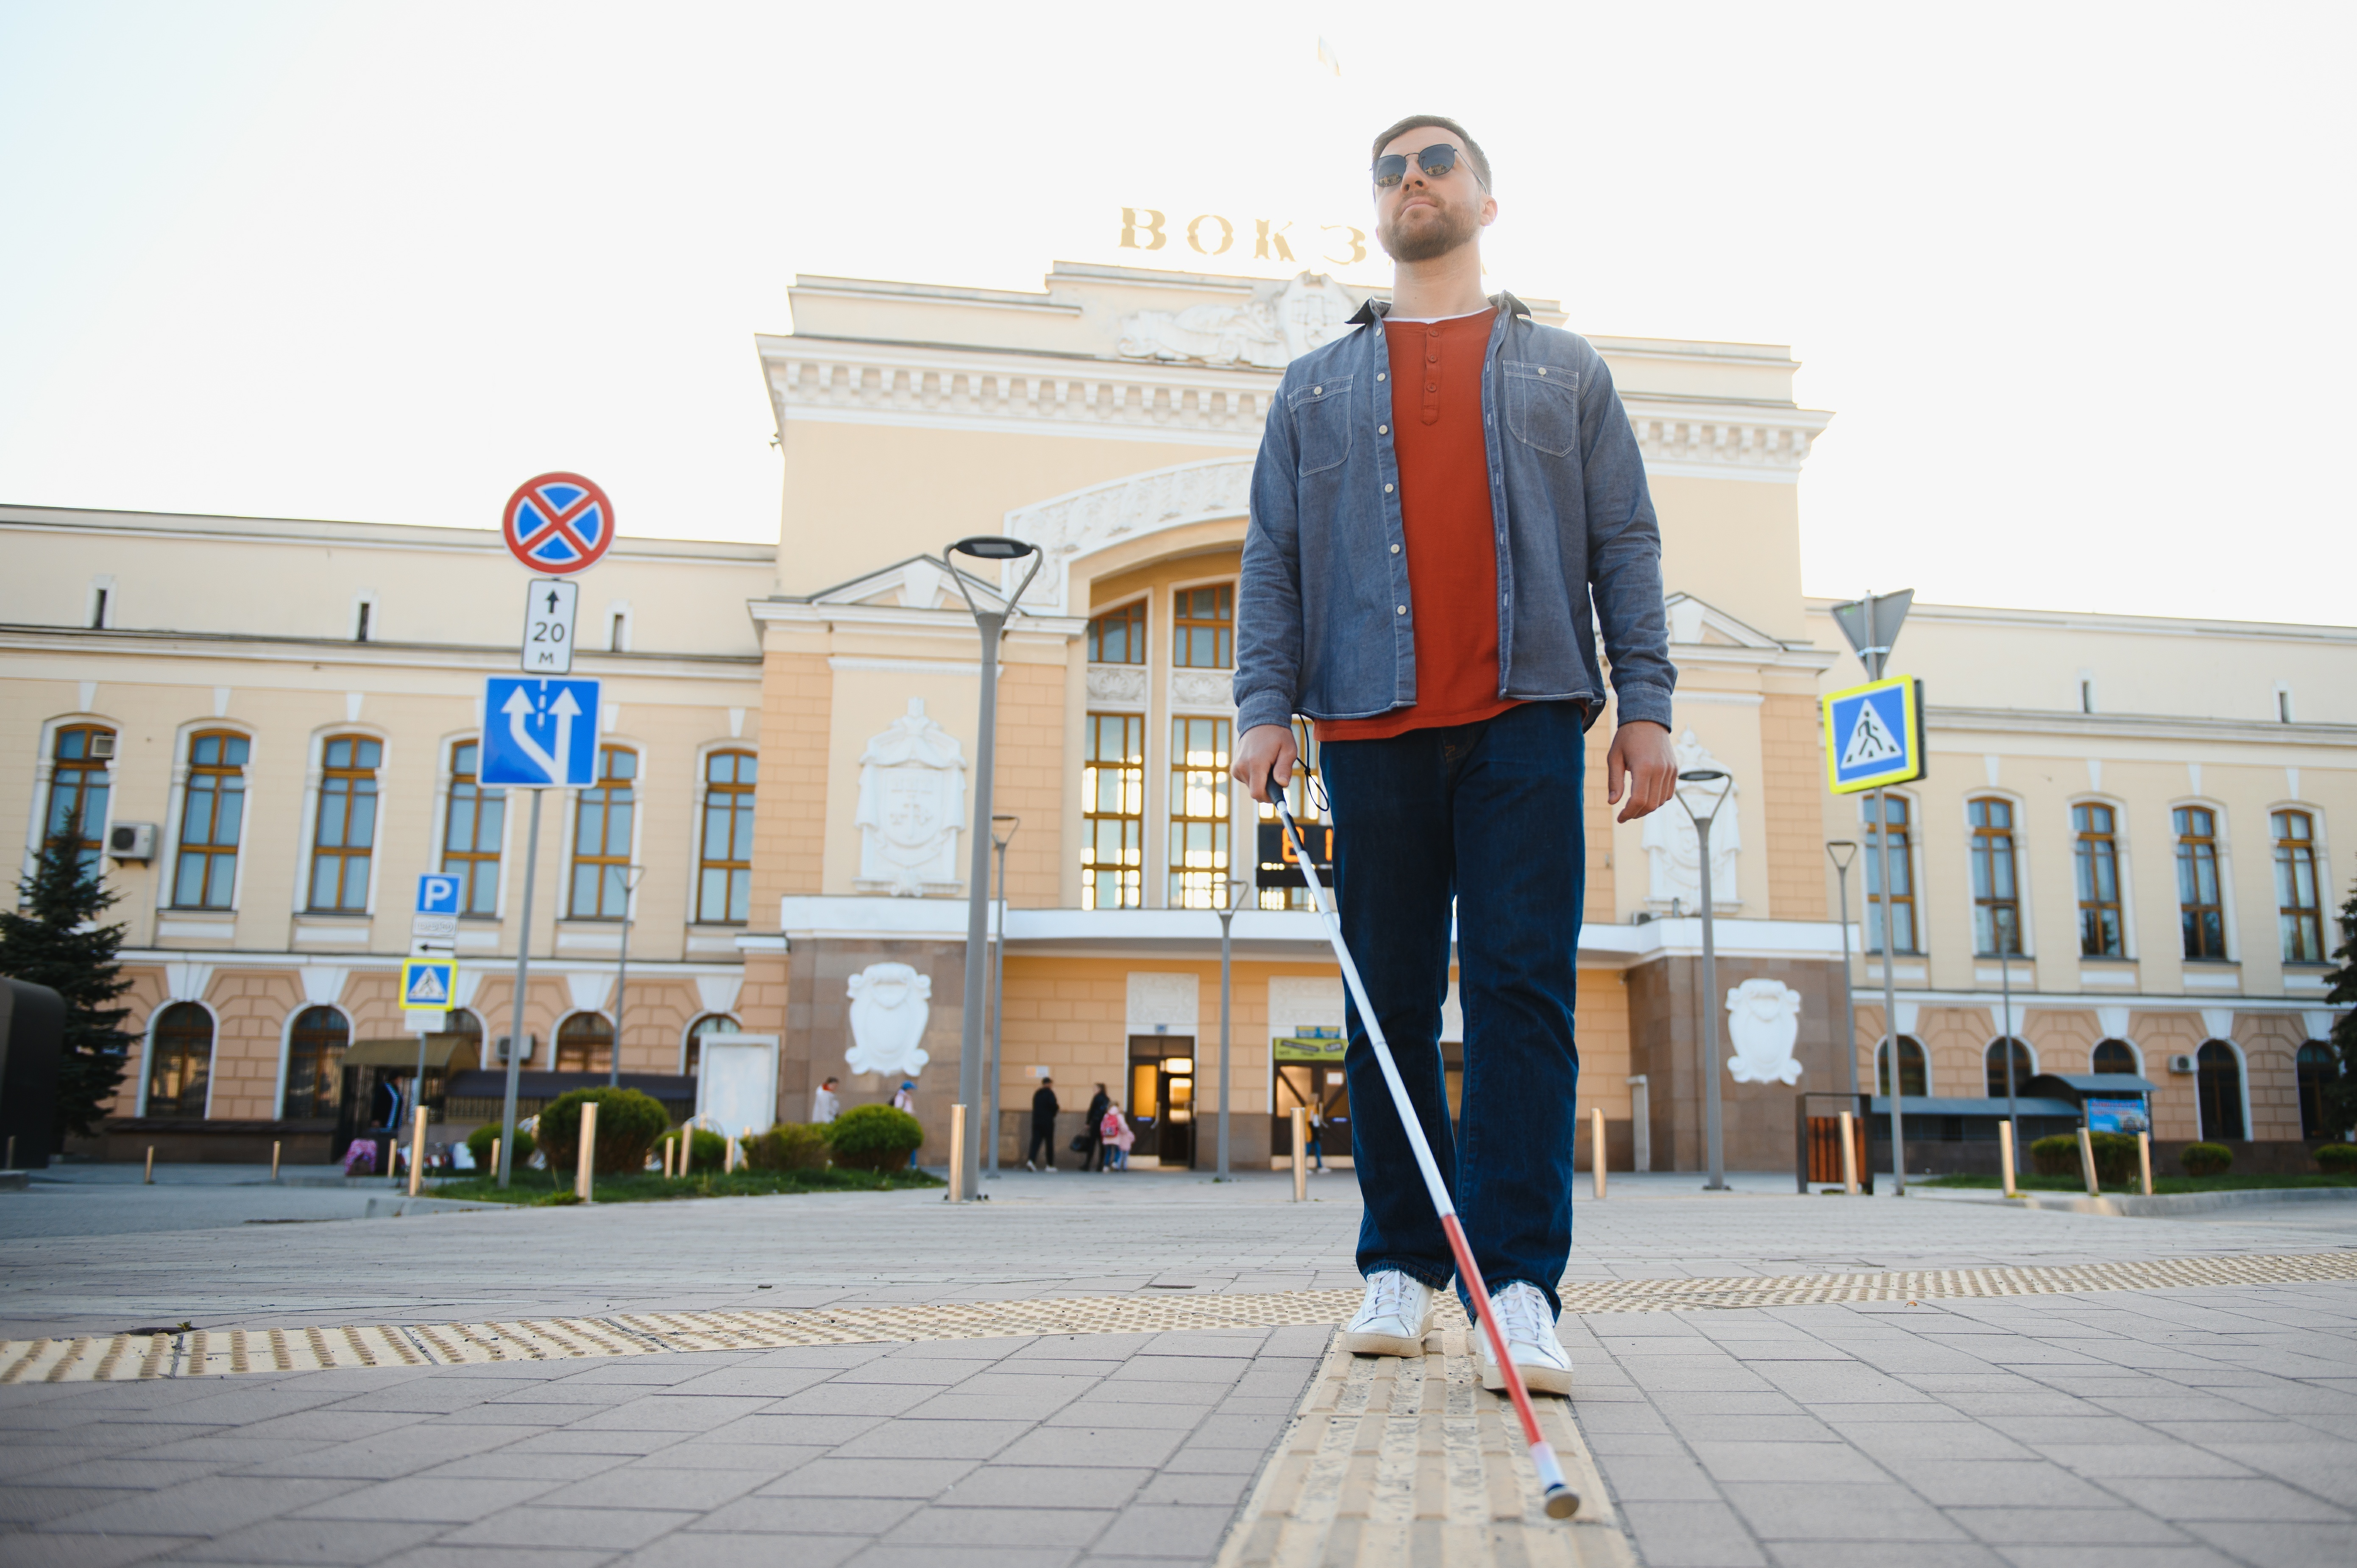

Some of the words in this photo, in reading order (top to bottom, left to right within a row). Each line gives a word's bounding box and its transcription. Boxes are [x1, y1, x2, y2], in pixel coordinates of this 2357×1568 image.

[1118, 206, 1487, 275] ВОКЗ
[533, 622, 565, 643] 20
[424, 878, 452, 910] P
